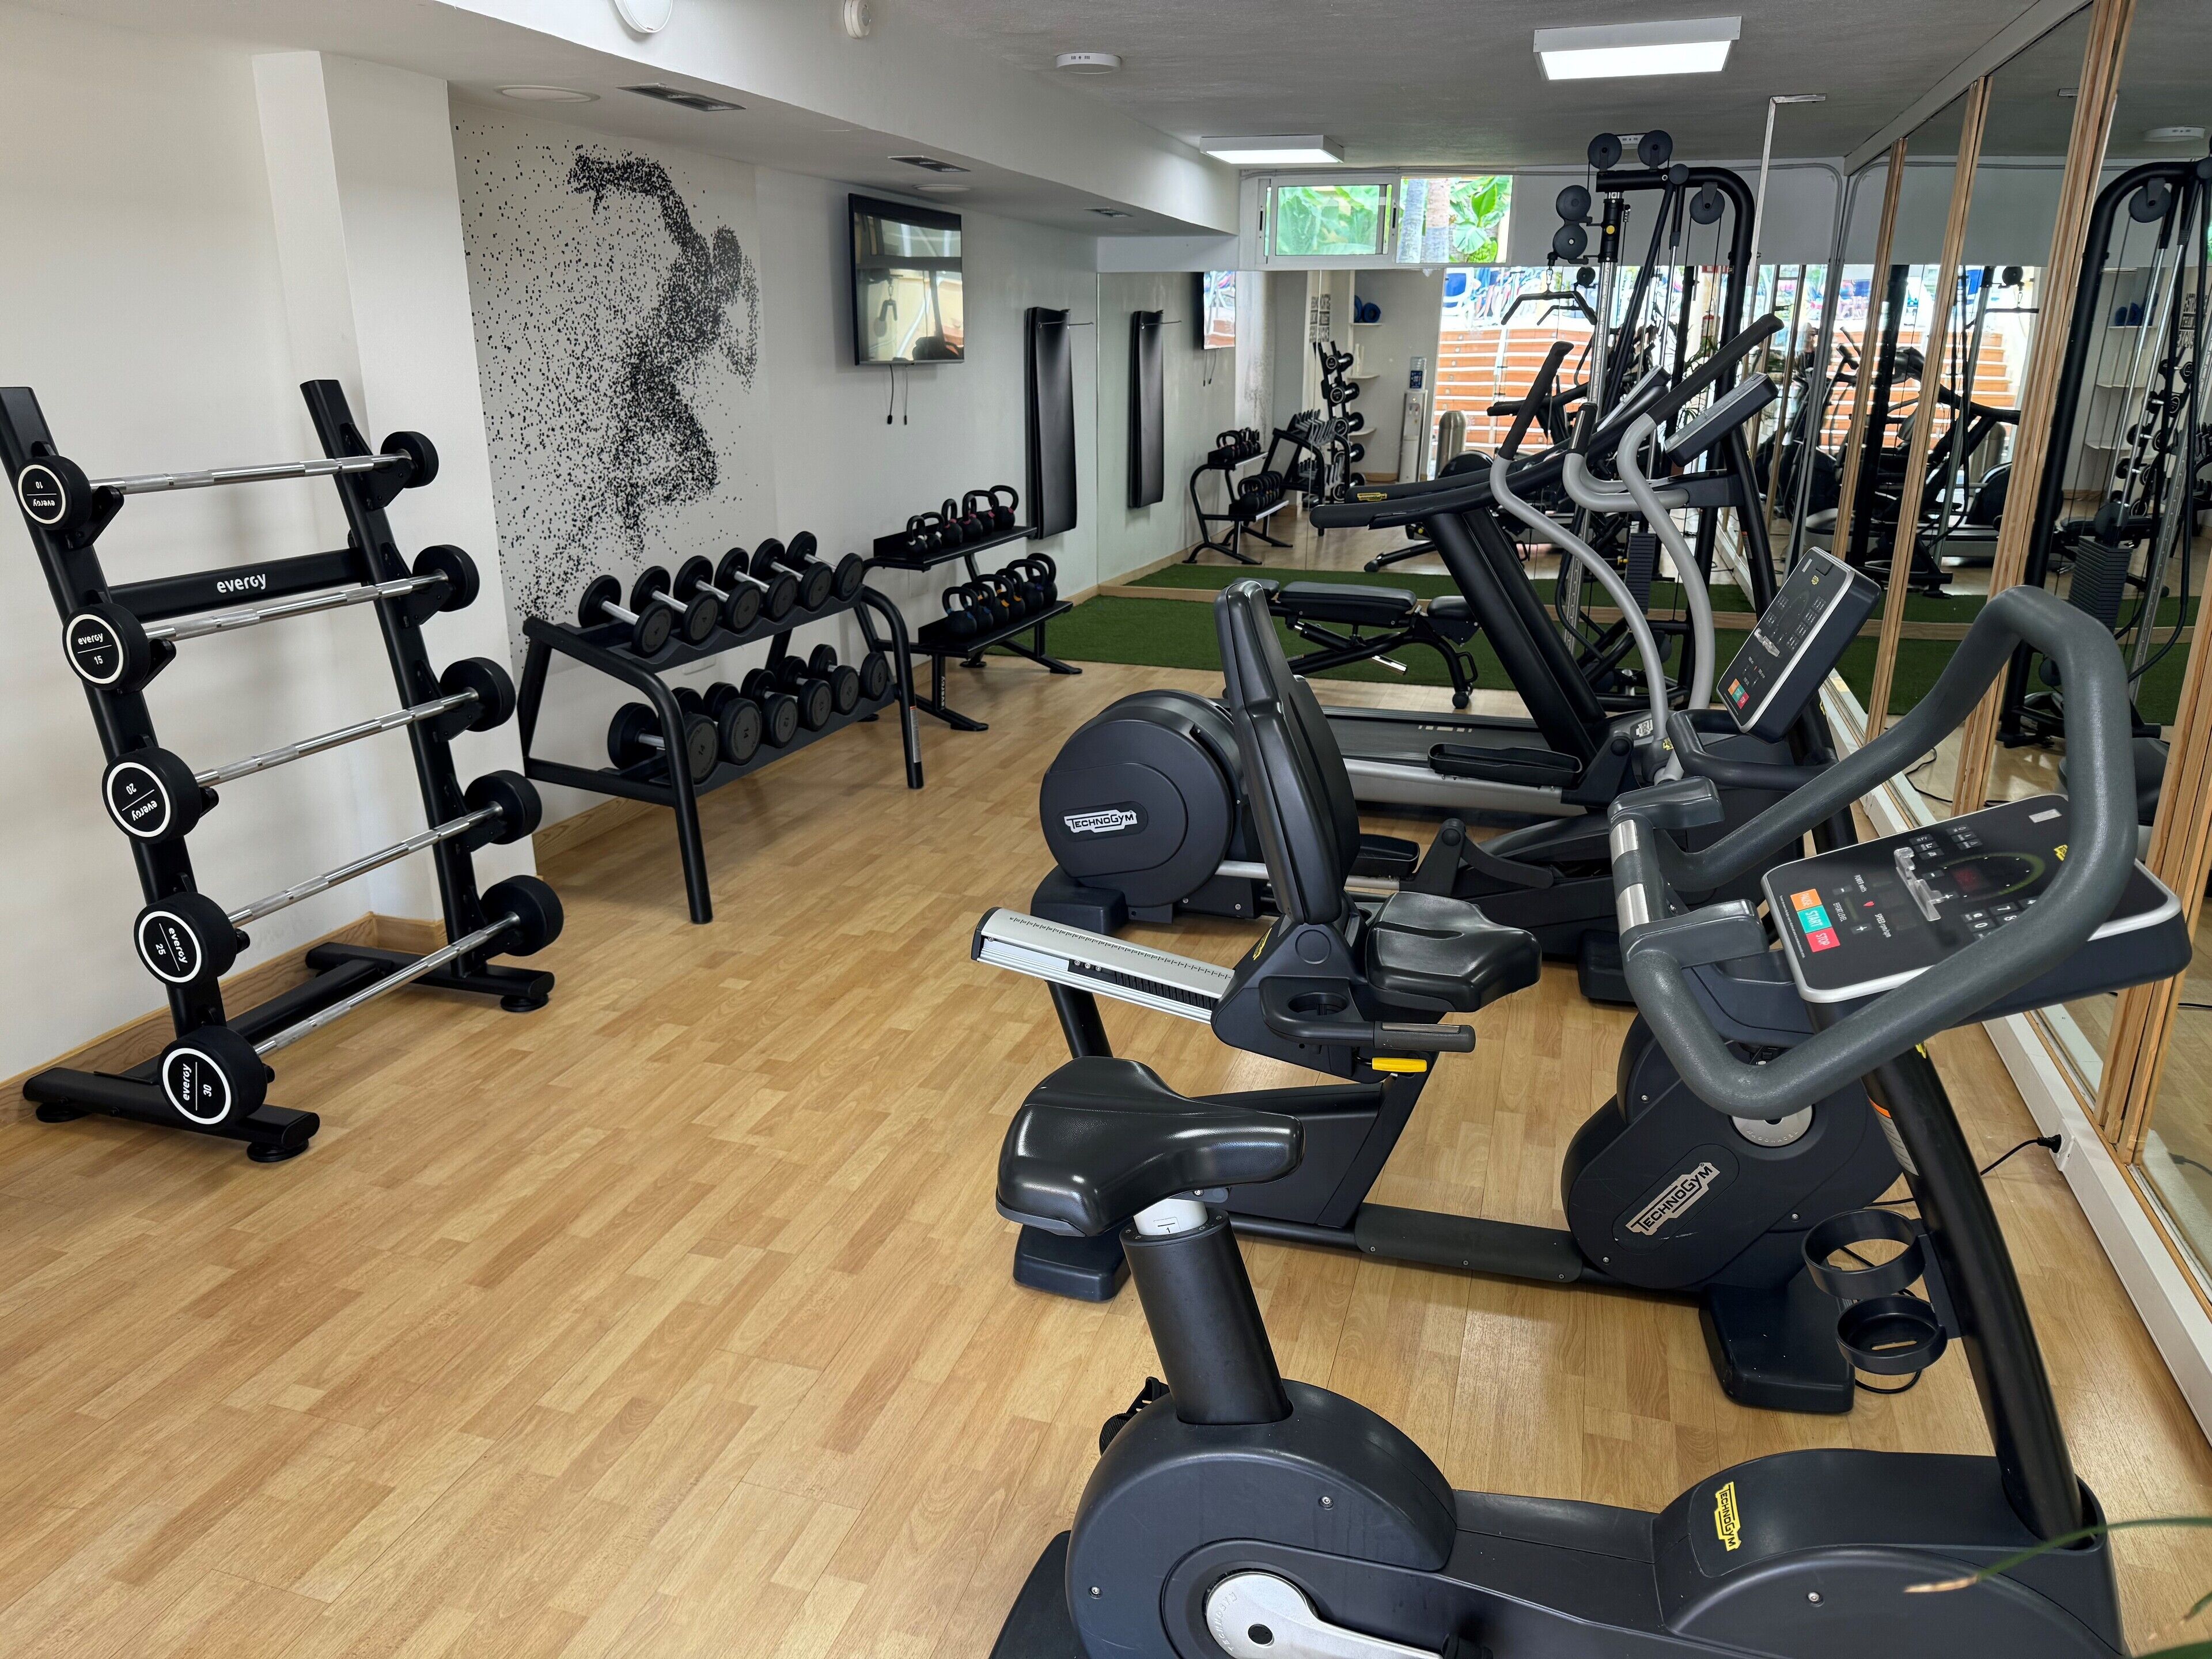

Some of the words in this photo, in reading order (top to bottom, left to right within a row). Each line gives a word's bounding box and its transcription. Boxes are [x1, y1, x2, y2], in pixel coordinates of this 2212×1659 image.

[35, 481, 44, 489] 10
[94, 655, 104, 665] 15
[126, 783, 137, 795] 20
[1805, 910, 1824, 927] START
[1815, 932, 1831, 946] STOP
[155, 943, 166, 955] 25
[203, 1084, 212, 1097] 30
[1630, 1165, 1713, 1232] TECHNOGYM
[1718, 1484, 1736, 1547] TECHNOGYM
